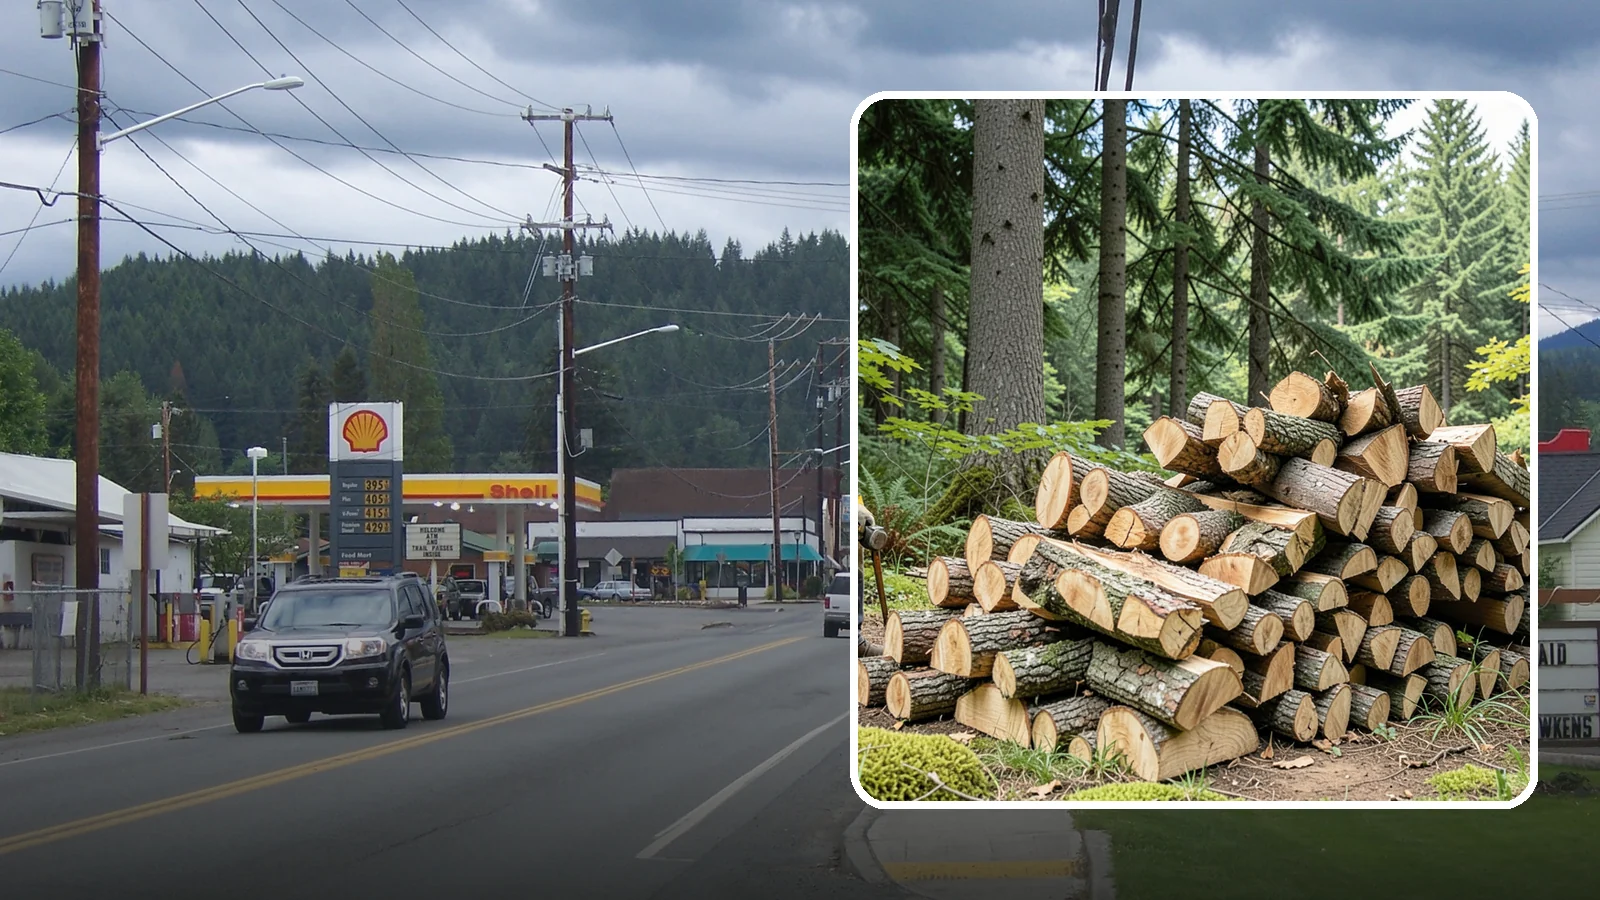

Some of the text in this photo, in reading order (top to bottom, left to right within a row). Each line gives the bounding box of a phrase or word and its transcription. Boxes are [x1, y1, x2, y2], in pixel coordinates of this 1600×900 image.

[366, 480, 384, 490] 395
[490, 484, 547, 498] Shell
[366, 494, 384, 504] 405
[366, 508, 383, 518] 415
[366, 522, 384, 532] 429
[1538, 642, 1567, 666] AID
